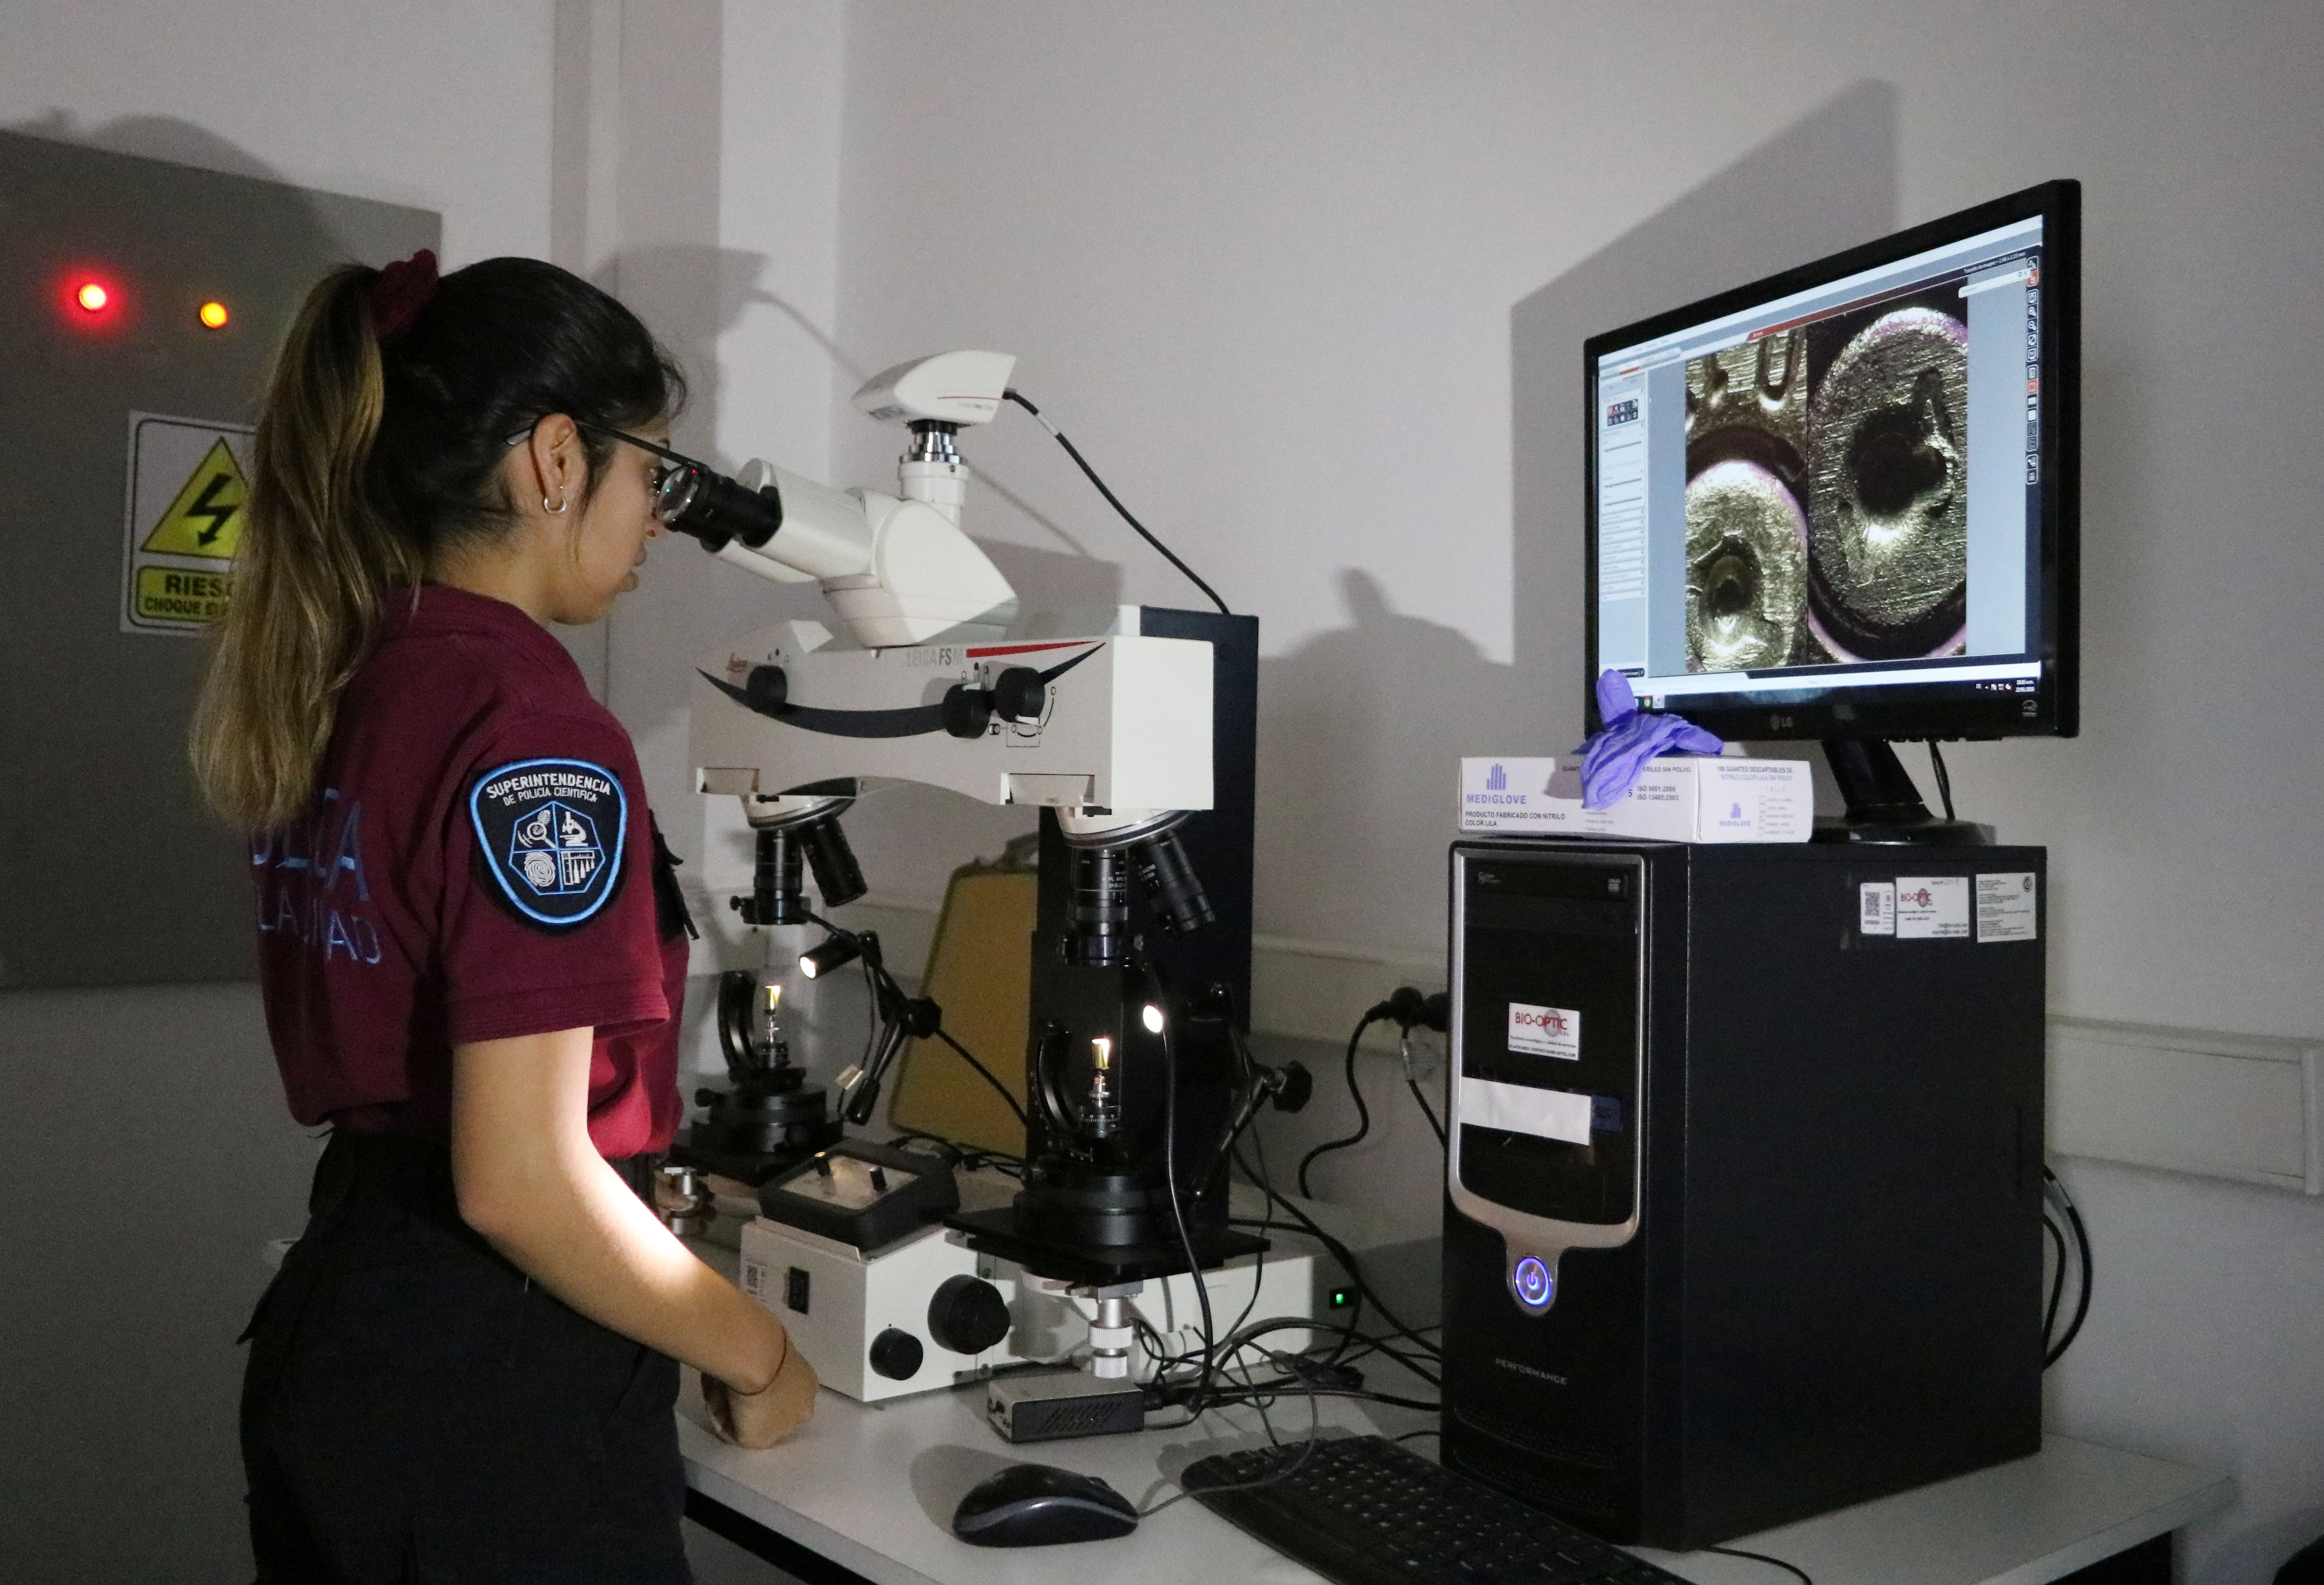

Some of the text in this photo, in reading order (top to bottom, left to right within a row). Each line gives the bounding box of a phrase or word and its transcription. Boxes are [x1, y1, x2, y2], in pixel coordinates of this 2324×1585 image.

[165, 574, 232, 597] RIES
[145, 597, 200, 614] CHOQUE
[486, 773, 610, 799] SUPERINTENDENCIA
[502, 787, 598, 806] DE POLICIA CIENTIFICA
[1466, 794, 1527, 804] MEDIGLOVE
[1515, 1012, 1567, 1030] BIO-OPTIC
[1495, 1357, 1567, 1385] PERFORMANCE
